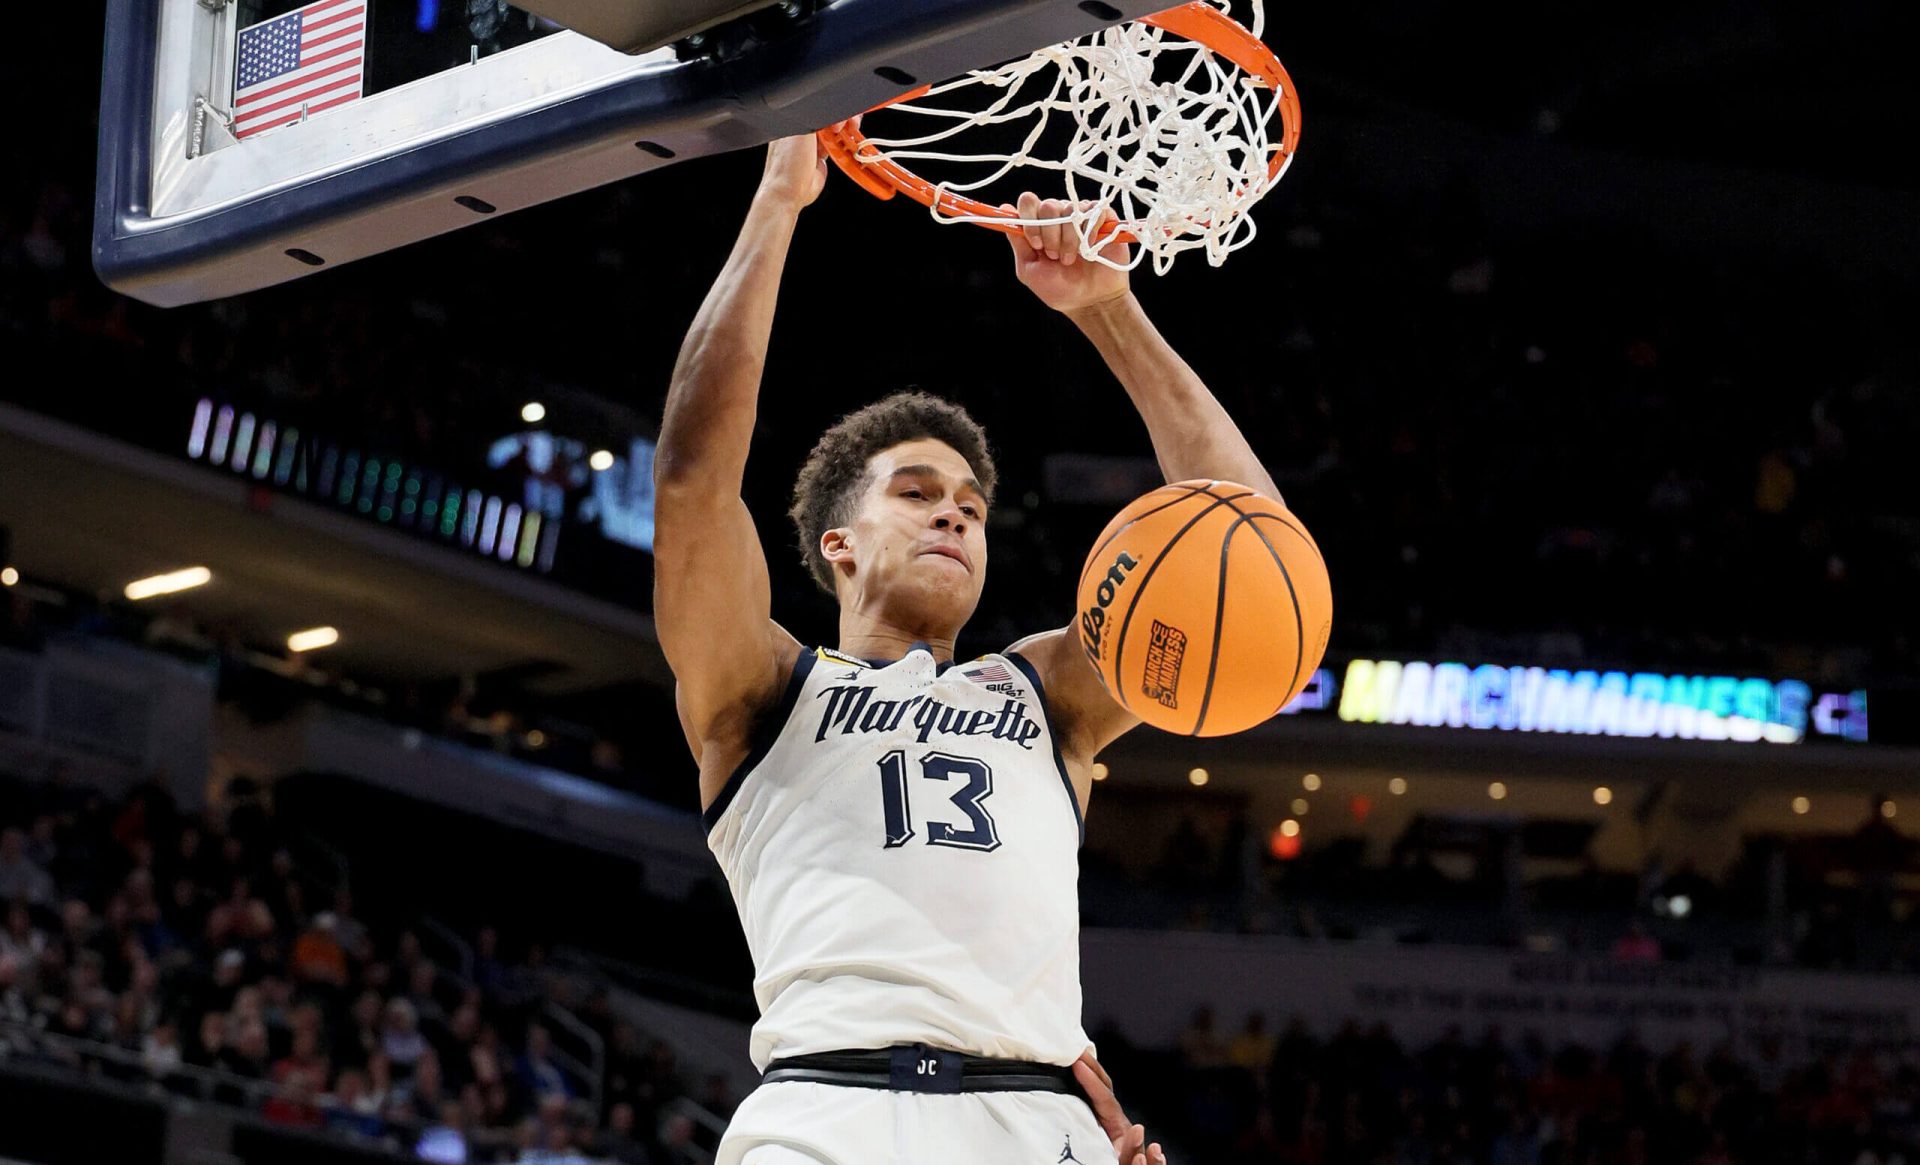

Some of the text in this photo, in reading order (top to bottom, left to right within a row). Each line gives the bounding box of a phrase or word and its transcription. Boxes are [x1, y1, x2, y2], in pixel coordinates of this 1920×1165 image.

[1144, 644, 1163, 689] MARCH
[1159, 628, 1183, 690] MADNESS
[985, 682, 1013, 691] BIG
[815, 686, 1041, 749] Marquette
[876, 750, 1002, 852] 13
[917, 1059, 937, 1075] JC
